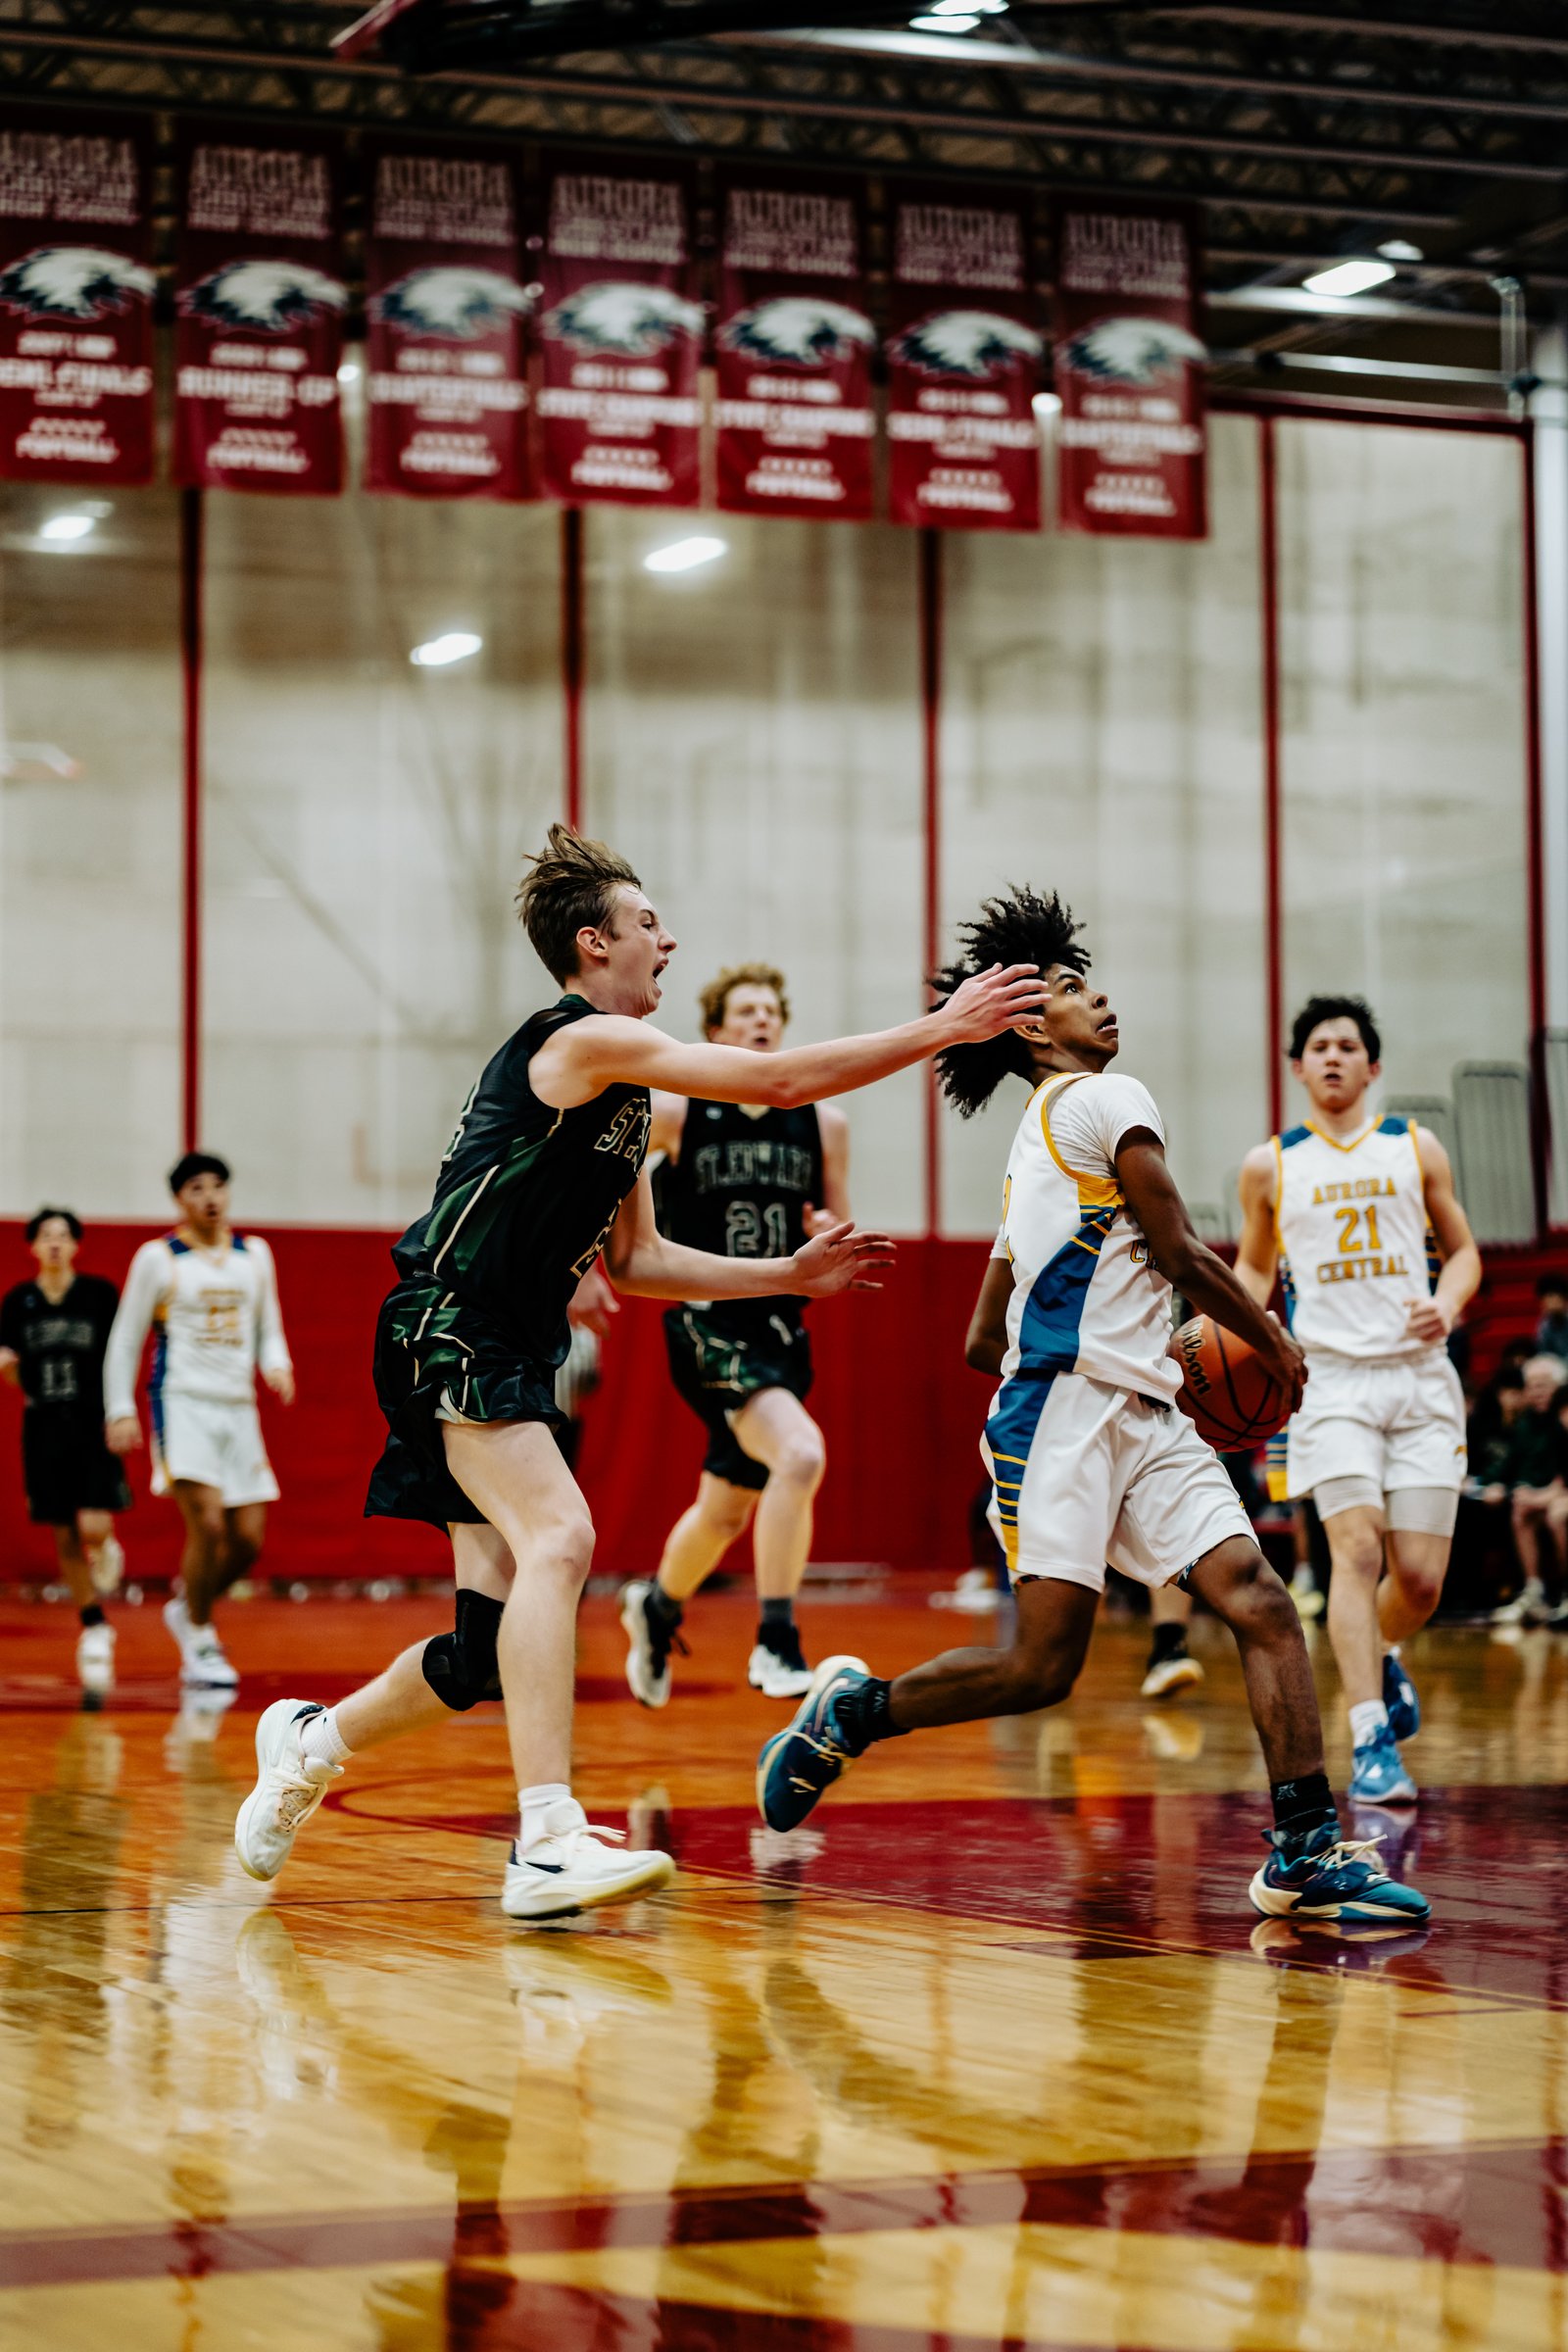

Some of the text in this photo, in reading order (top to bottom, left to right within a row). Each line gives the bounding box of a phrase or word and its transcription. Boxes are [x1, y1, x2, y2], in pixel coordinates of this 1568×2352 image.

[1312, 1177, 1396, 1205] AURORA
[726, 1200, 787, 1257] 21
[1335, 1204, 1382, 1253] 21
[1316, 1255, 1409, 1285] CENTRAL
